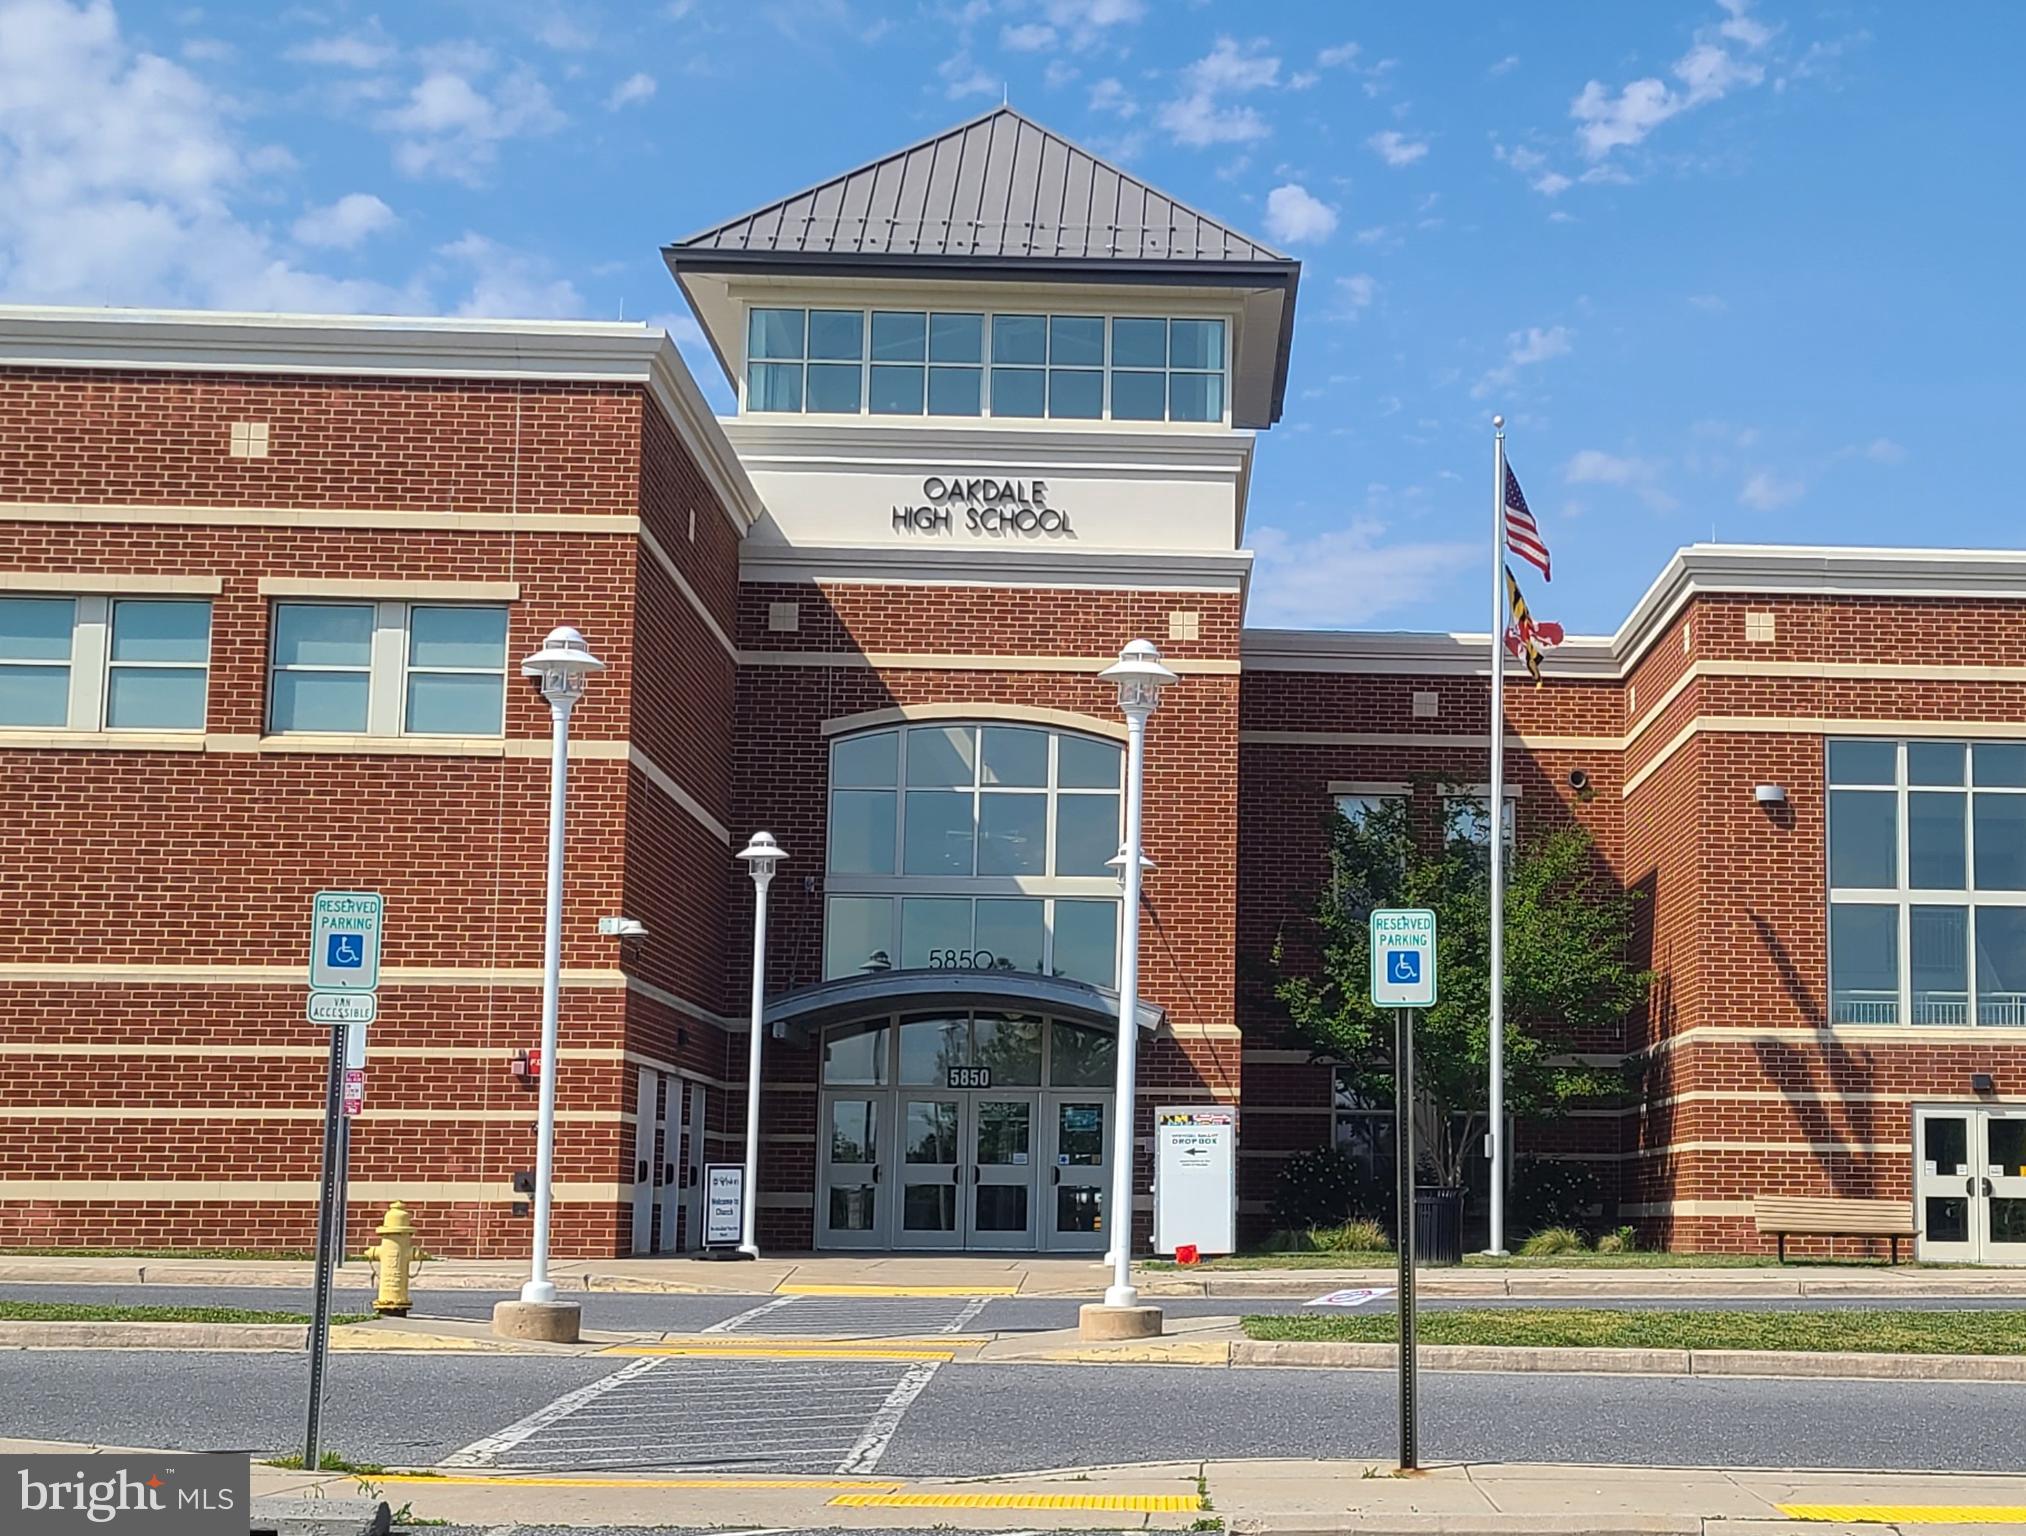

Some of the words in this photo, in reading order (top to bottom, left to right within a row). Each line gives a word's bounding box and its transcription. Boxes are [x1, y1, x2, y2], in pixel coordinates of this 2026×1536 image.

[924, 477, 1045, 505] OAKDALE
[892, 506, 949, 530] HIGH
[965, 507, 1073, 533] SCHOOL
[319, 900, 377, 913] RESERVED
[321, 917, 372, 930] PARKING
[1376, 918, 1430, 930] RESERVED
[1380, 934, 1427, 946] PARKING
[929, 949, 994, 969] 5850
[334, 998, 351, 1007] VAN
[313, 1007, 370, 1018] ACCESSIBLE
[950, 1069, 989, 1086] 5850
